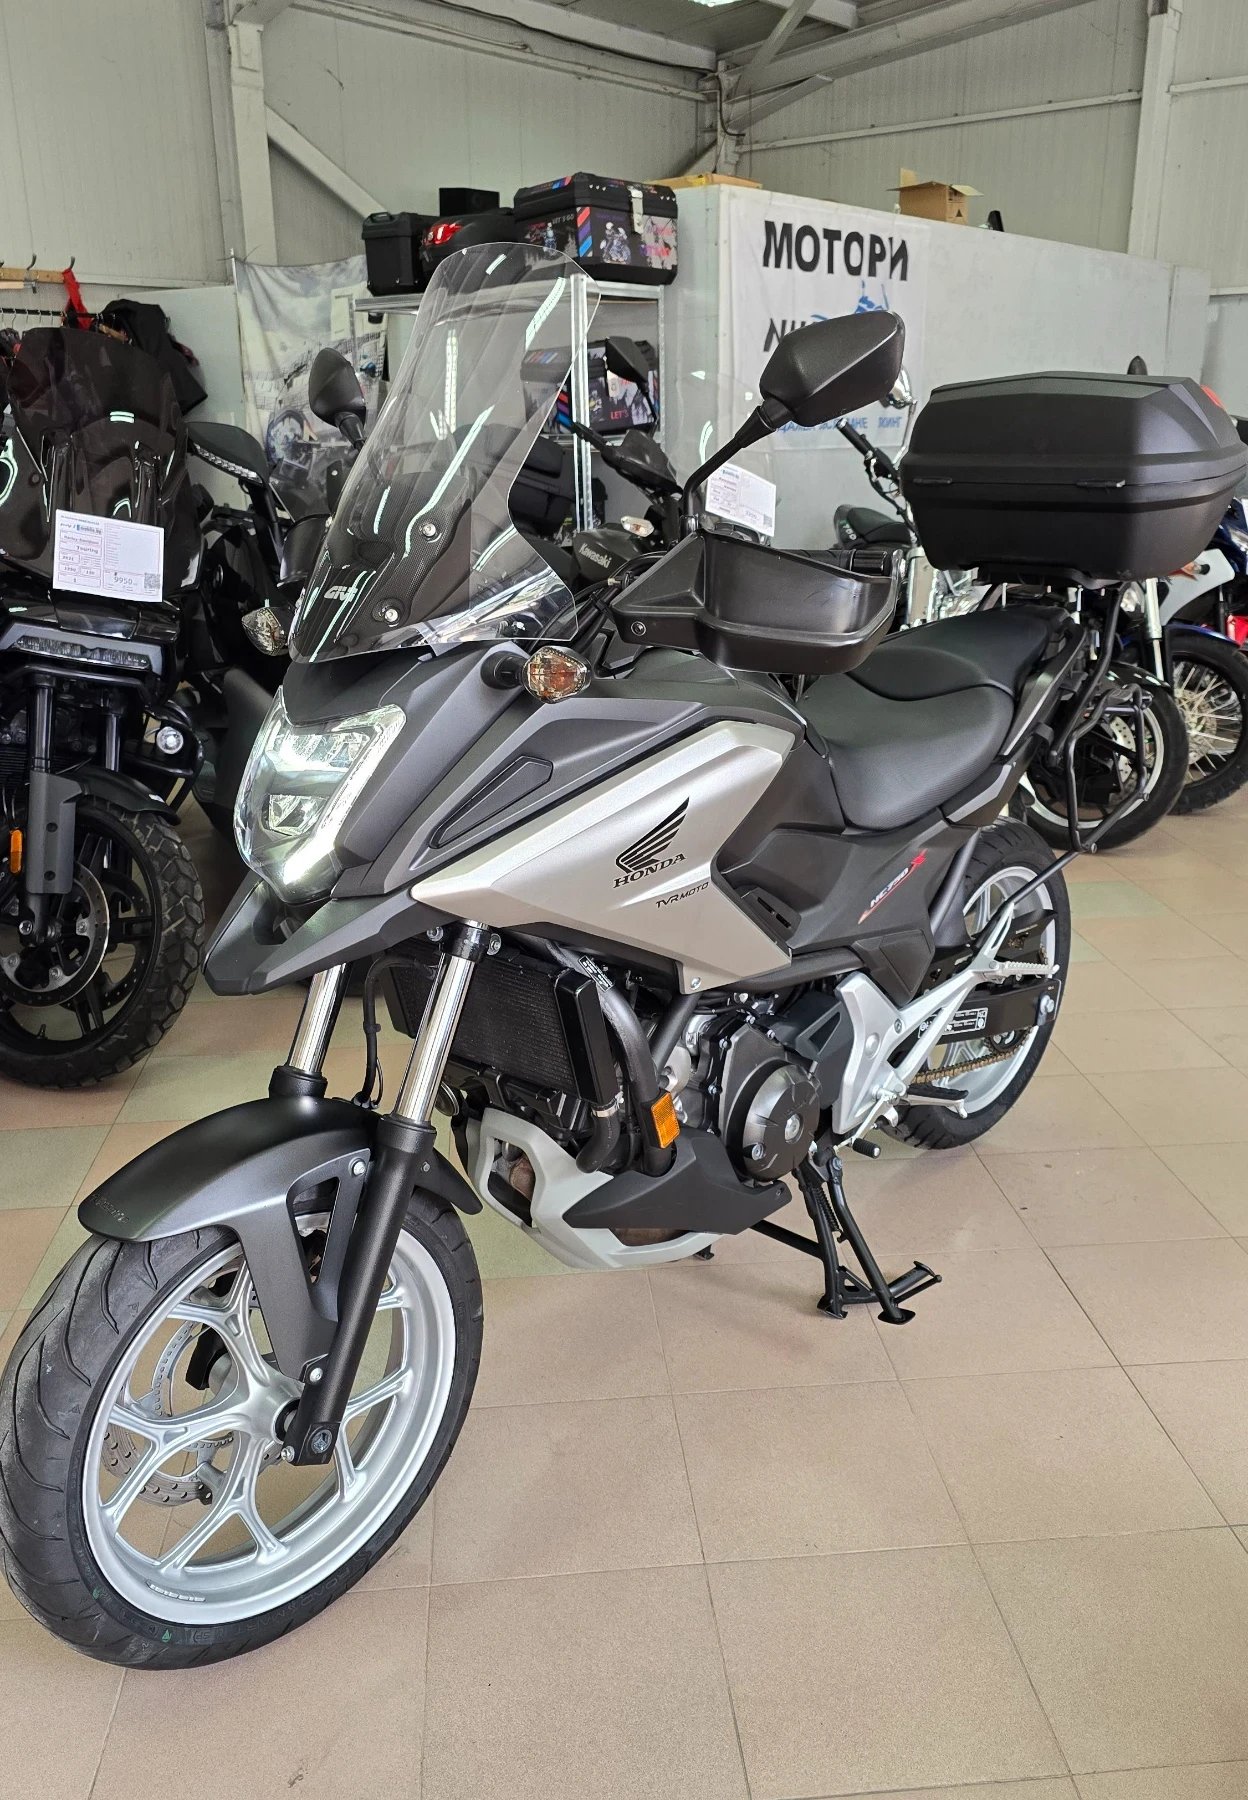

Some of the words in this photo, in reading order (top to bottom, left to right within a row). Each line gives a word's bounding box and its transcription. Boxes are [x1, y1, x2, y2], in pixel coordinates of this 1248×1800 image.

[763, 220, 908, 281] МОТОРИ
[579, 543, 612, 569] Kawasaki
[114, 576, 133, 585] 9950
[613, 853, 686, 888] HONDA
